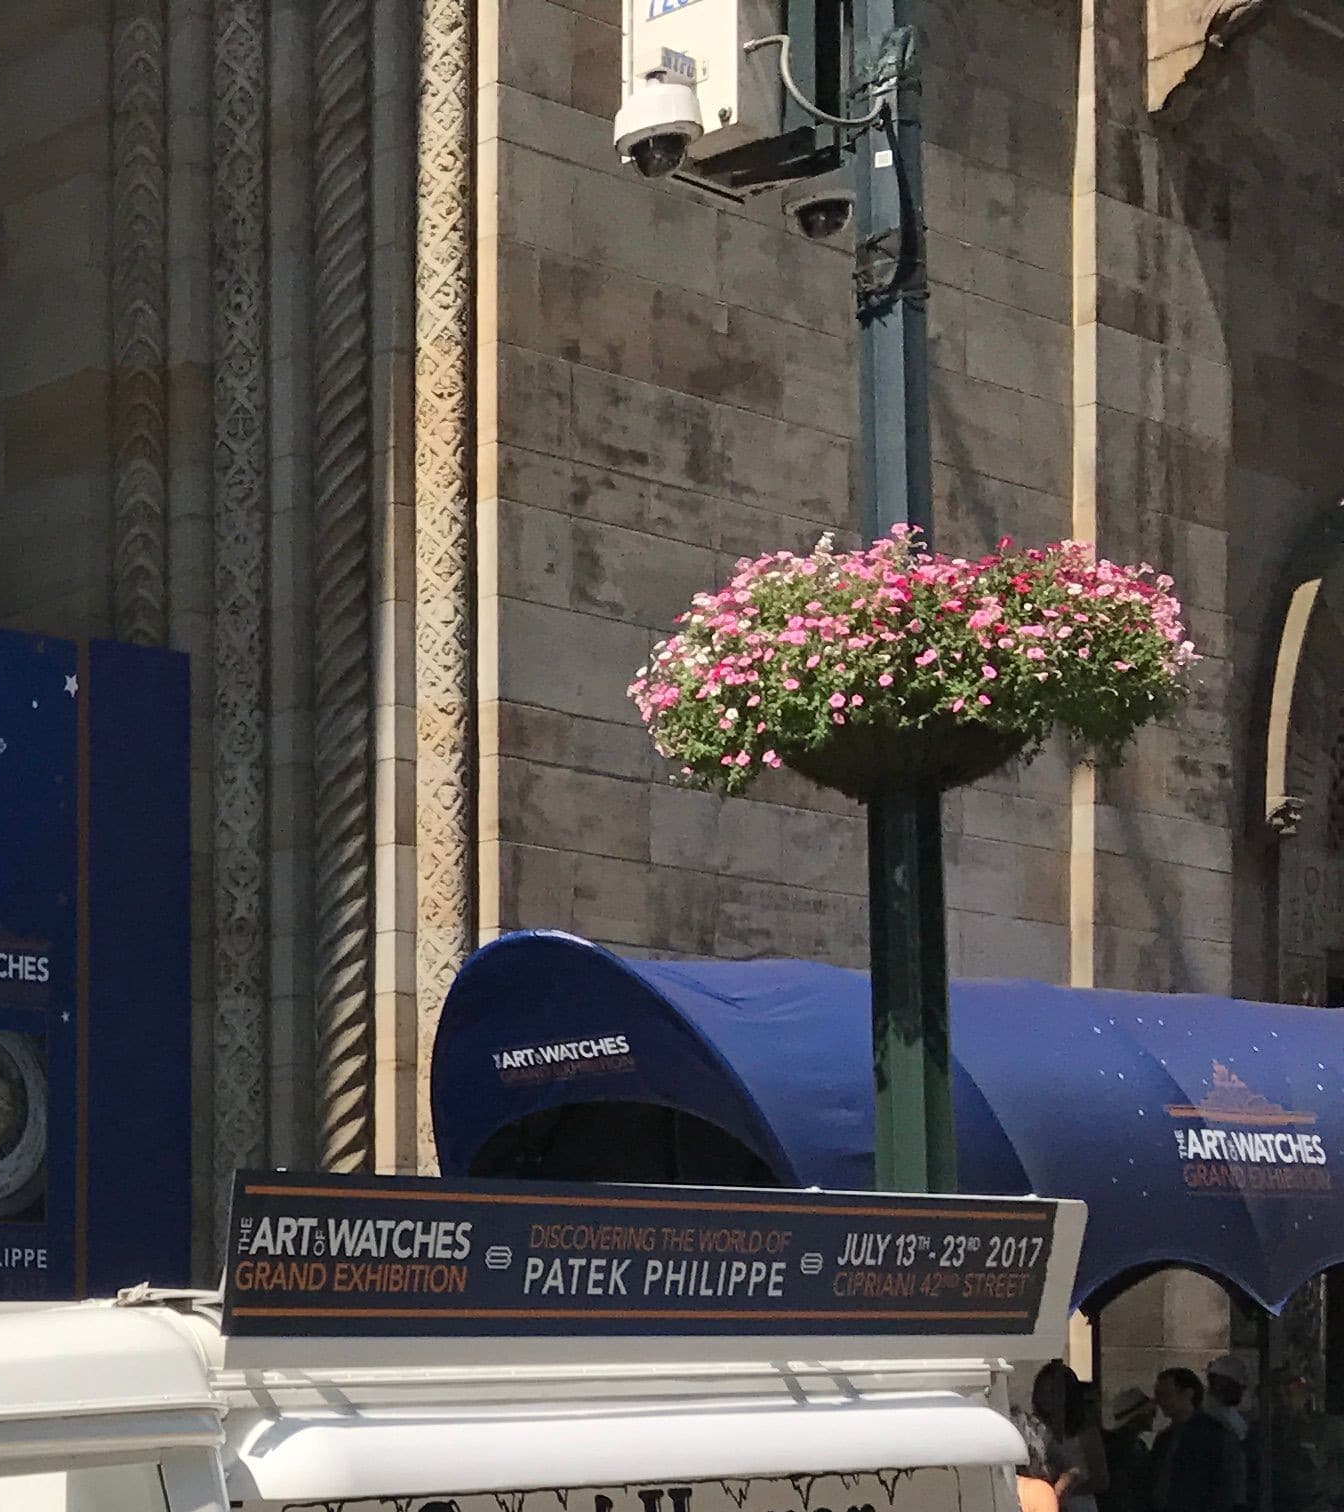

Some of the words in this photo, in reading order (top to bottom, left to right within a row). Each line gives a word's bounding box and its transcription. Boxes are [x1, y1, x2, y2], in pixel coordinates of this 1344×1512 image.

[502, 1049, 535, 1069] ART
[539, 1035, 630, 1063] WATCHES
[1188, 1129, 1229, 1160] ART
[1231, 1132, 1326, 1165] WATCHES
[238, 1217, 253, 1254] THE
[249, 1217, 318, 1256] ART
[314, 1230, 325, 1257] OF
[327, 1218, 473, 1260] WATCHES
[529, 1224, 656, 1251] DISCOVERING
[661, 1227, 695, 1251] THE
[700, 1228, 761, 1254] WORLD
[766, 1230, 792, 1255] OF
[837, 1233, 892, 1266] JULY
[985, 1236, 1043, 1268] 2017
[235, 1261, 327, 1291] GRAND
[333, 1262, 468, 1293] EXHIBITION
[523, 1257, 632, 1295] PATEK
[643, 1259, 787, 1297] PHILIPPE
[832, 1272, 915, 1297] CIPRIANI
[962, 1273, 1029, 1298] STREET
